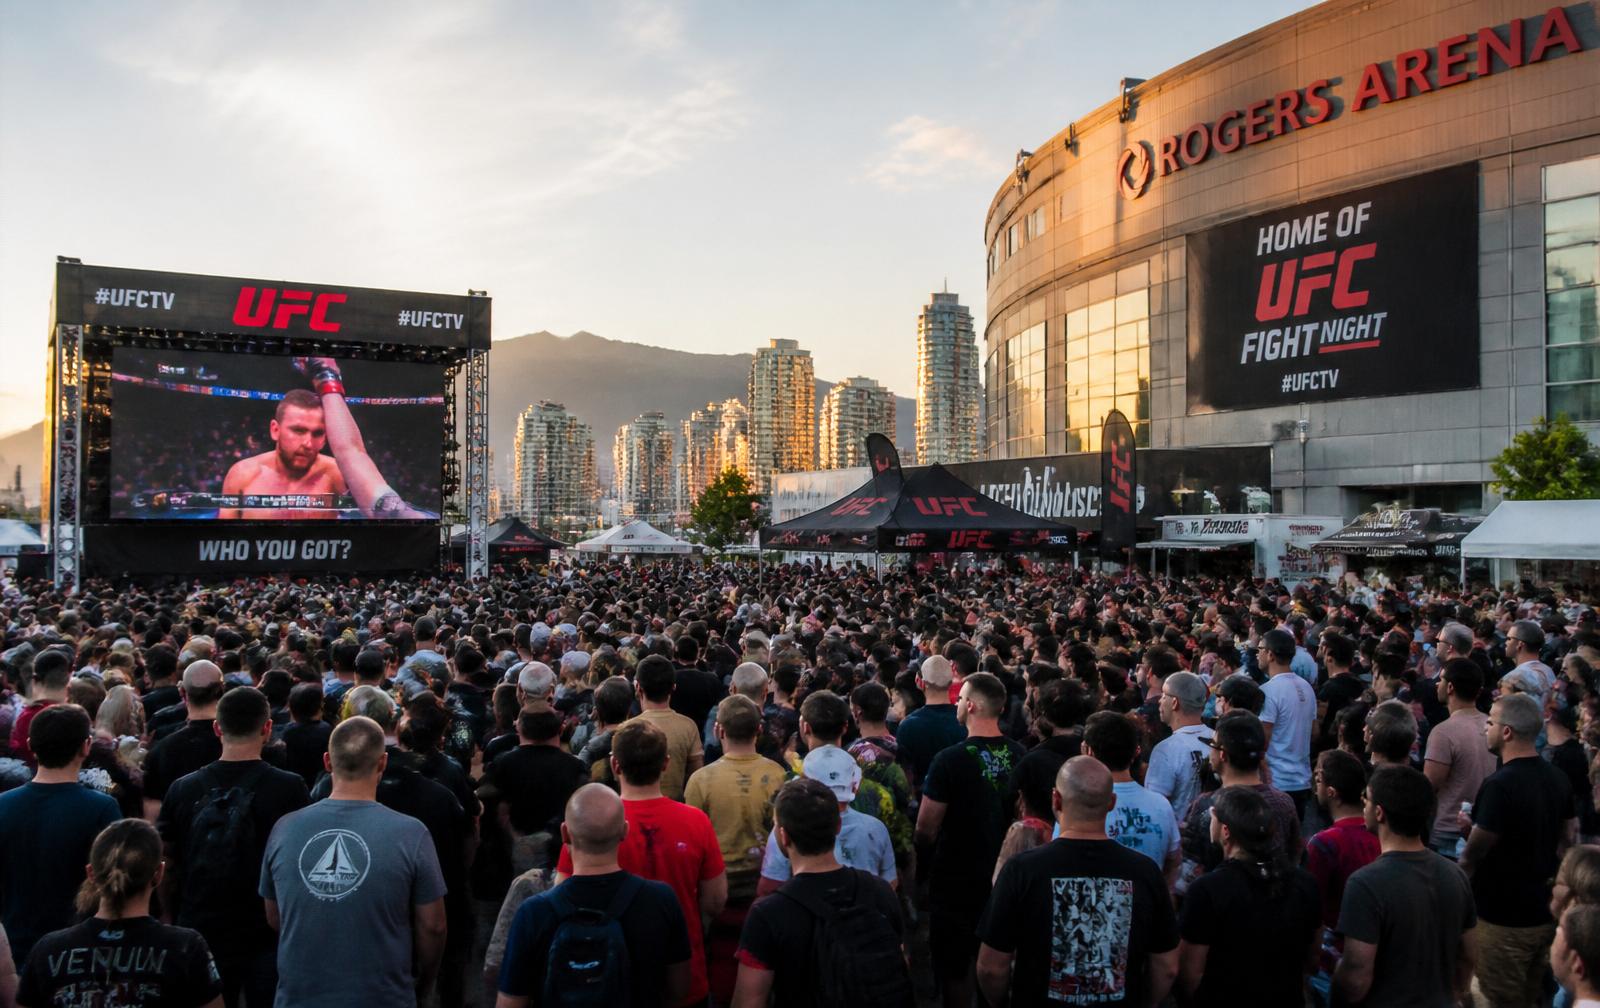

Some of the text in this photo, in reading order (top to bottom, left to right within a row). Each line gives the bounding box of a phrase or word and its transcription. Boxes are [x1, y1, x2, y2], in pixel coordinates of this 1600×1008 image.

[1159, 6, 1583, 177] ROGERS ARENA
[1256, 201, 1372, 256] HOME OF
[1255, 242, 1378, 322] UFC
[94, 287, 176, 311] #UFCTV
[232, 286, 348, 333] UFC
[398, 309, 464, 330] #UFCTV
[1240, 312, 1388, 365] FIGHT NIGHT
[1281, 369, 1340, 393] #UFCTV
[830, 496, 889, 517] UFC
[912, 496, 988, 517] UFC
[199, 538, 352, 561] WHO YOU GOT?
[947, 529, 994, 549] UFC
